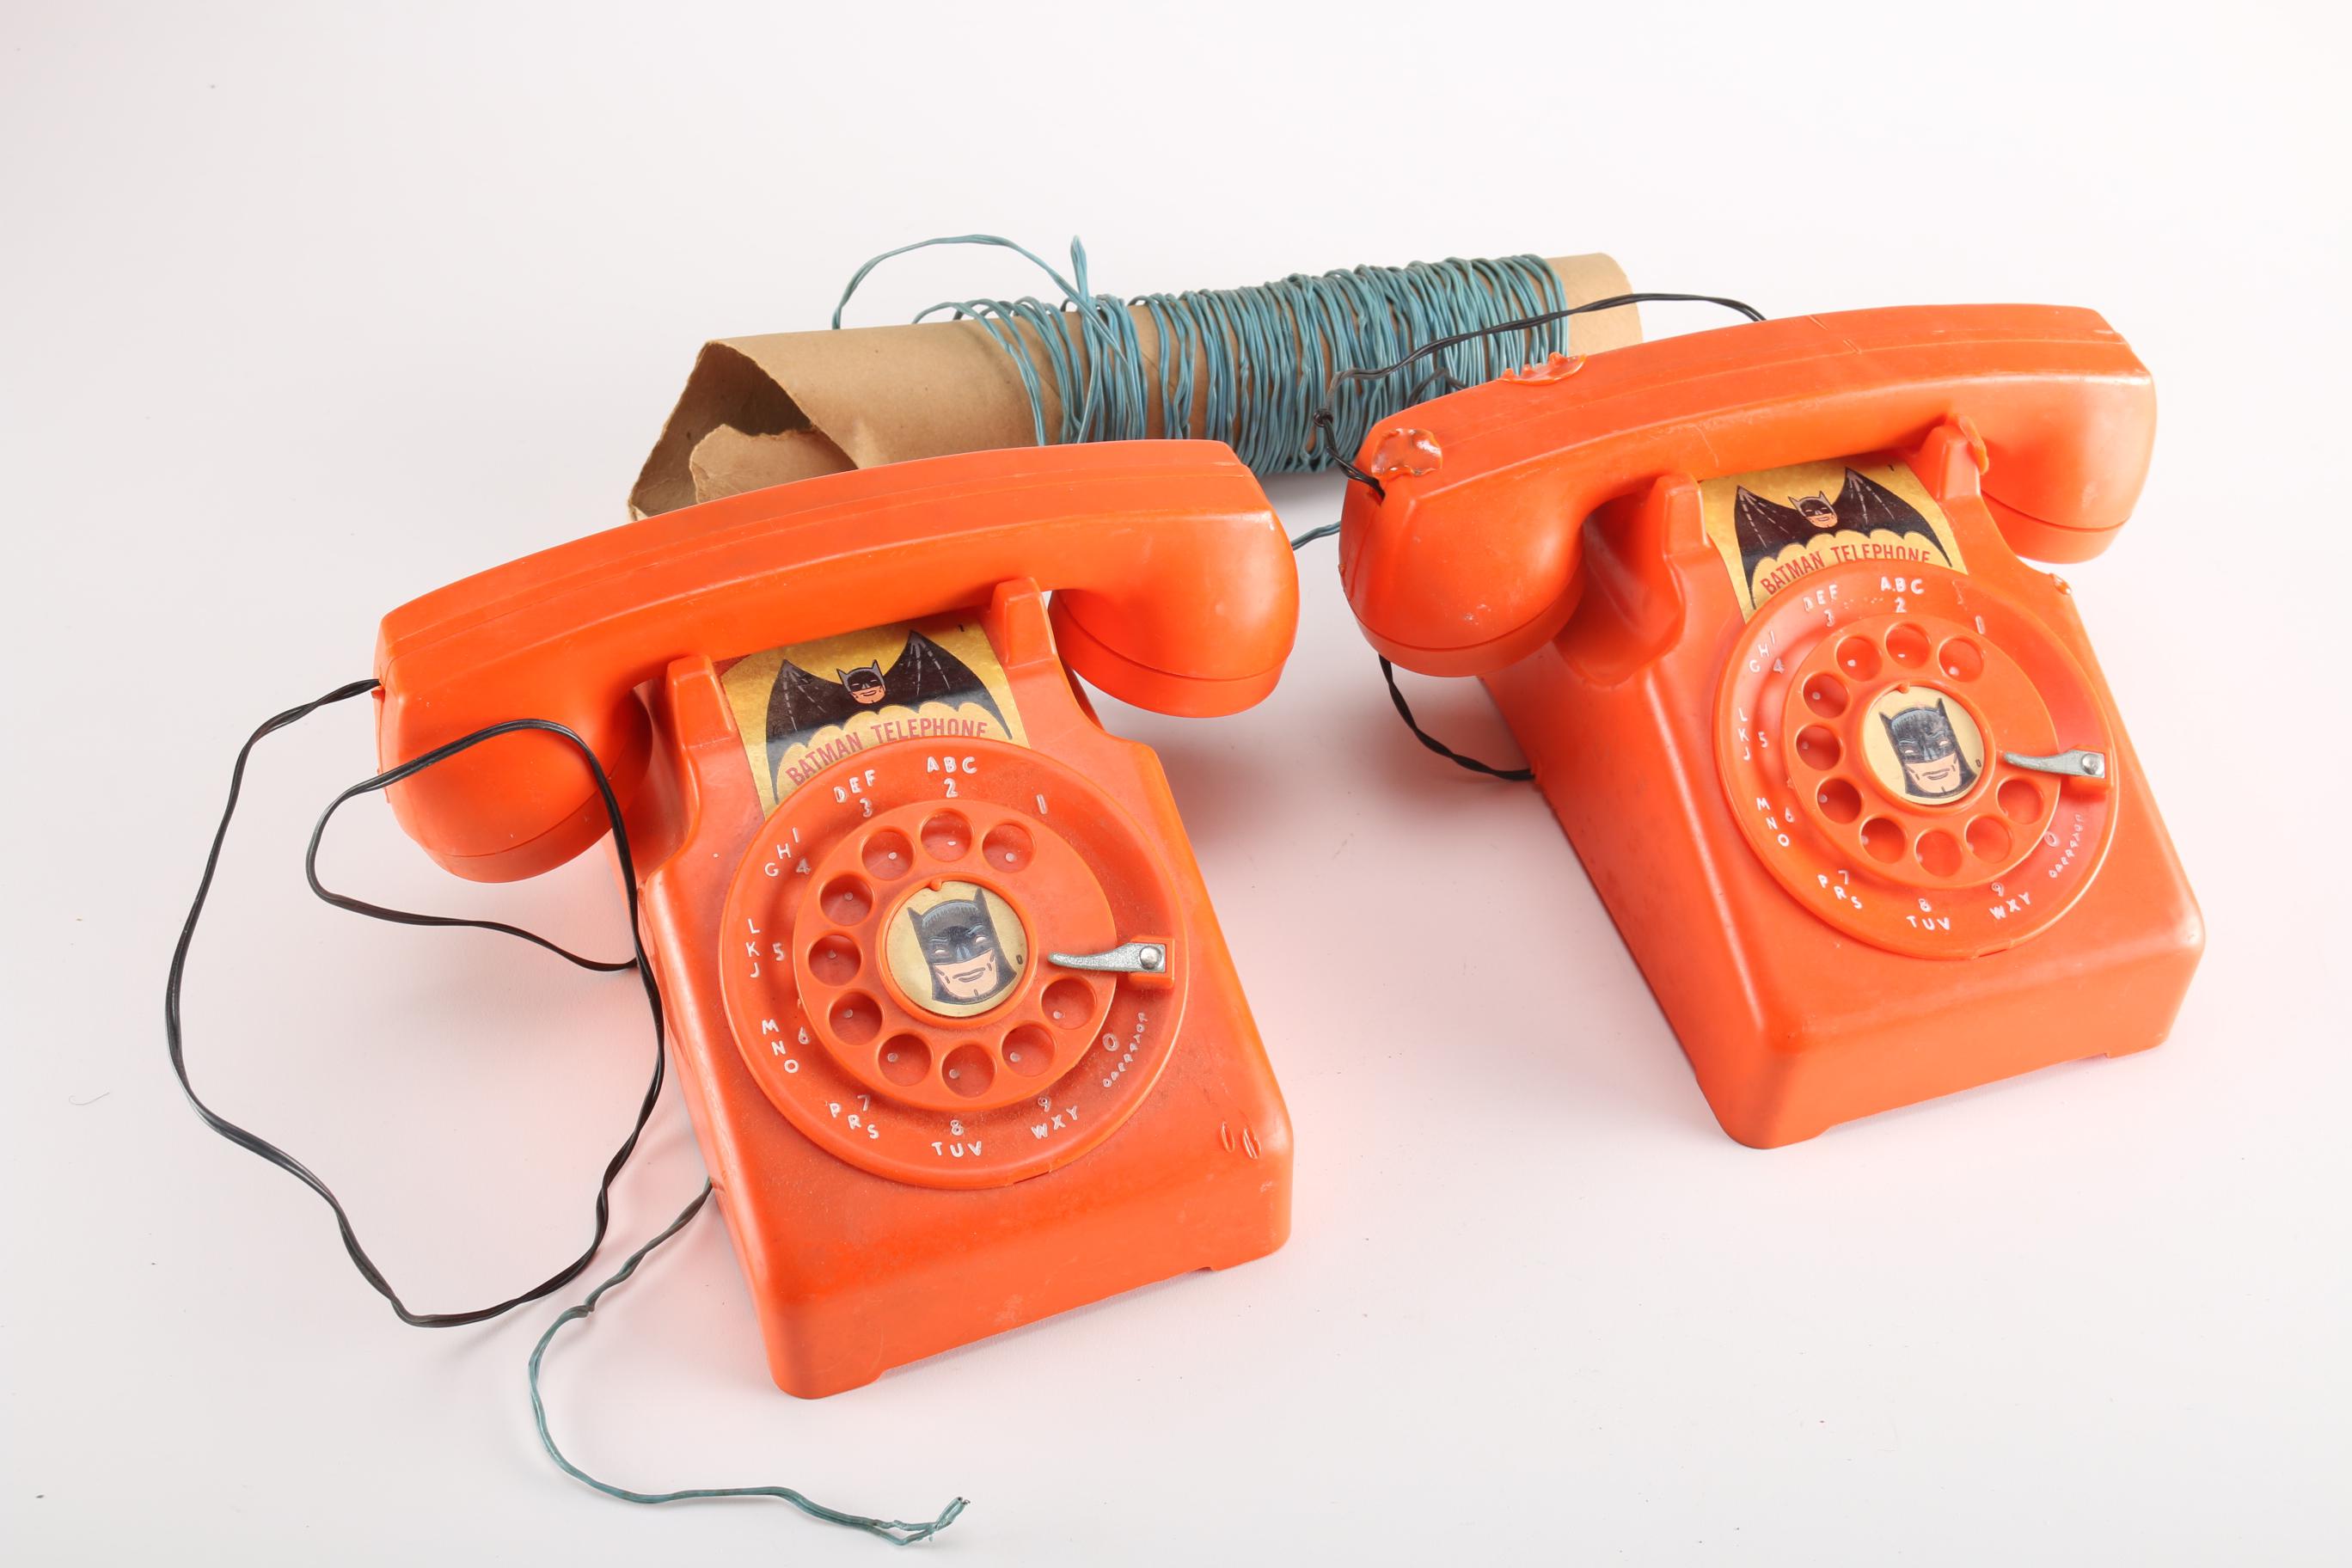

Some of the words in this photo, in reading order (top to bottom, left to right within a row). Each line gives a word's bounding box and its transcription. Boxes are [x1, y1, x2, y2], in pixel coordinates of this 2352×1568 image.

[1761, 551, 1825, 595] BATMAN
[1830, 543, 1932, 564] TELEPHONE
[1880, 577, 1925, 595] ABC
[1803, 584, 1839, 611] DEF
[1895, 597, 1906, 613] 2
[1823, 609, 1834, 628] 3
[1749, 629, 1777, 674] GHI
[1773, 657, 1785, 674] 4
[1758, 732, 1768, 748] 5
[785, 732, 863, 787] BATMAN
[870, 718, 988, 744] TELEPHONE
[927, 756, 977, 774] ABC
[833, 769, 876, 804] DEF
[944, 777, 959, 798] 2
[859, 797, 873, 818] 3
[1785, 807, 1795, 823] 6
[1756, 796, 1791, 848] MNO
[764, 827, 799, 878] GHI
[795, 857, 812, 875] 4
[1838, 869, 1850, 885] 7
[1817, 873, 1863, 910] PRS
[1991, 881, 2005, 897] 9
[1918, 897, 1932, 913] 8
[1989, 891, 2031, 921] WXY
[1906, 914, 1951, 932] TUV
[772, 942, 786, 962] 5
[798, 1026, 810, 1044] 6
[762, 1019, 799, 1074] MNO
[857, 1093, 871, 1112] 7
[1037, 1095, 1051, 1112] 9
[826, 1100, 879, 1140] PRS
[950, 1119, 965, 1136] 8
[1031, 1105, 1080, 1140] WXY
[931, 1140, 983, 1158] TUV
